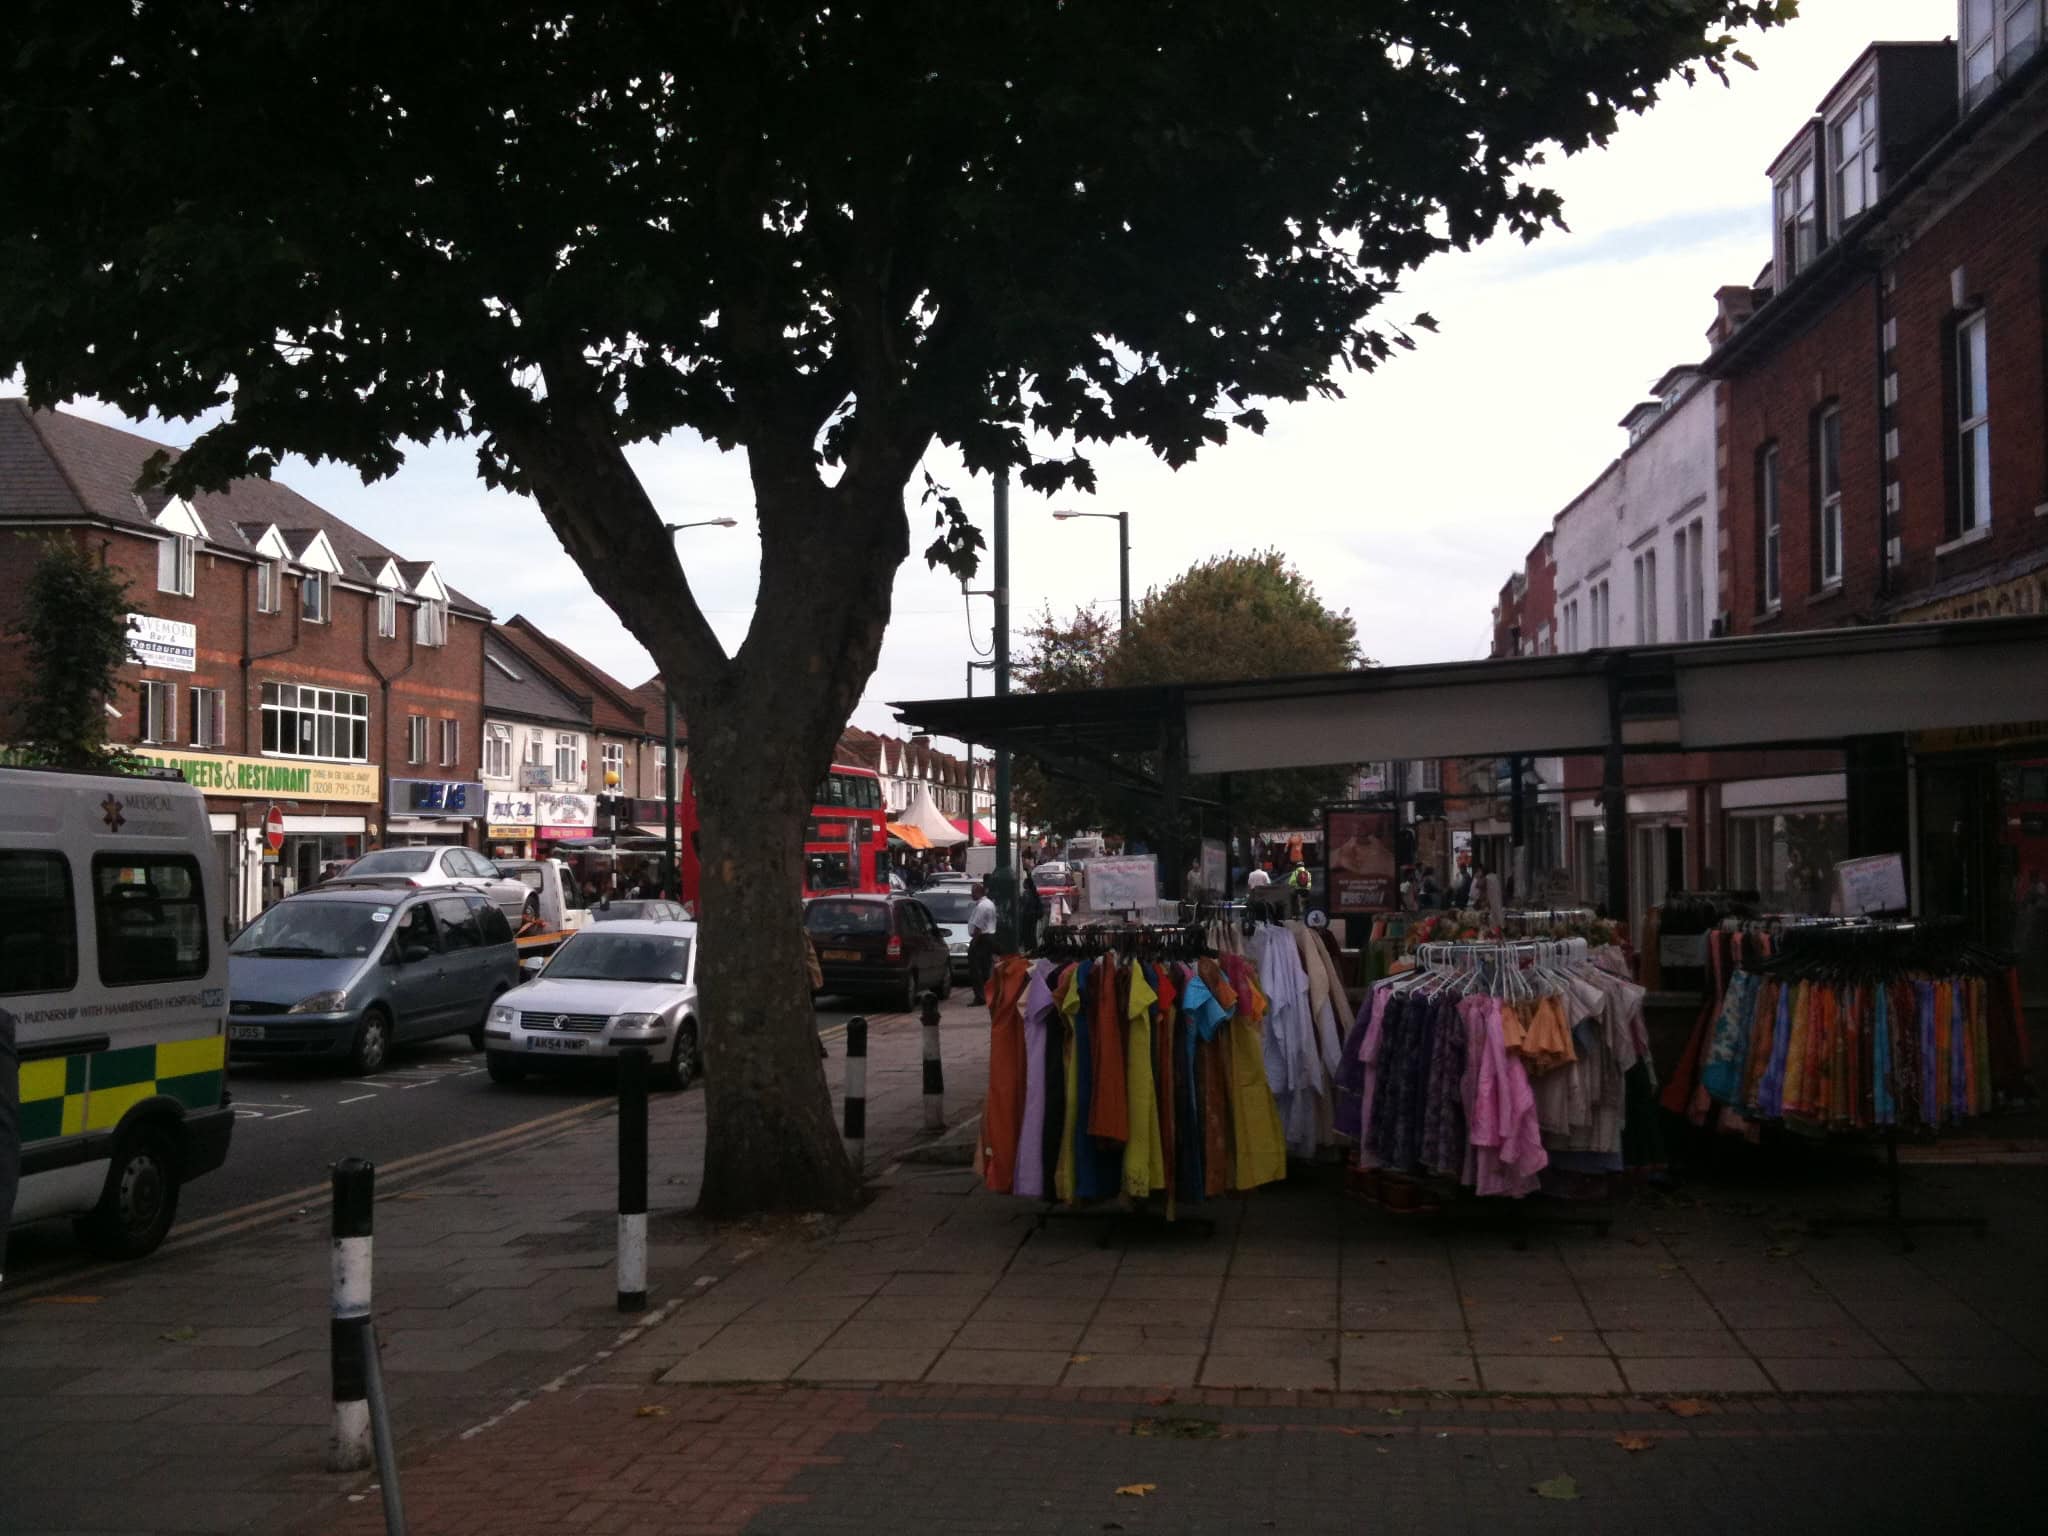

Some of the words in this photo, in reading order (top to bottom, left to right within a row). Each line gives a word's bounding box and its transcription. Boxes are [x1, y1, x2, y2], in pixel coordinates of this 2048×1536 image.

[130, 639, 193, 657] Restaurant
[225, 760, 236, 790] &
[238, 763, 311, 793] RESTAURANT
